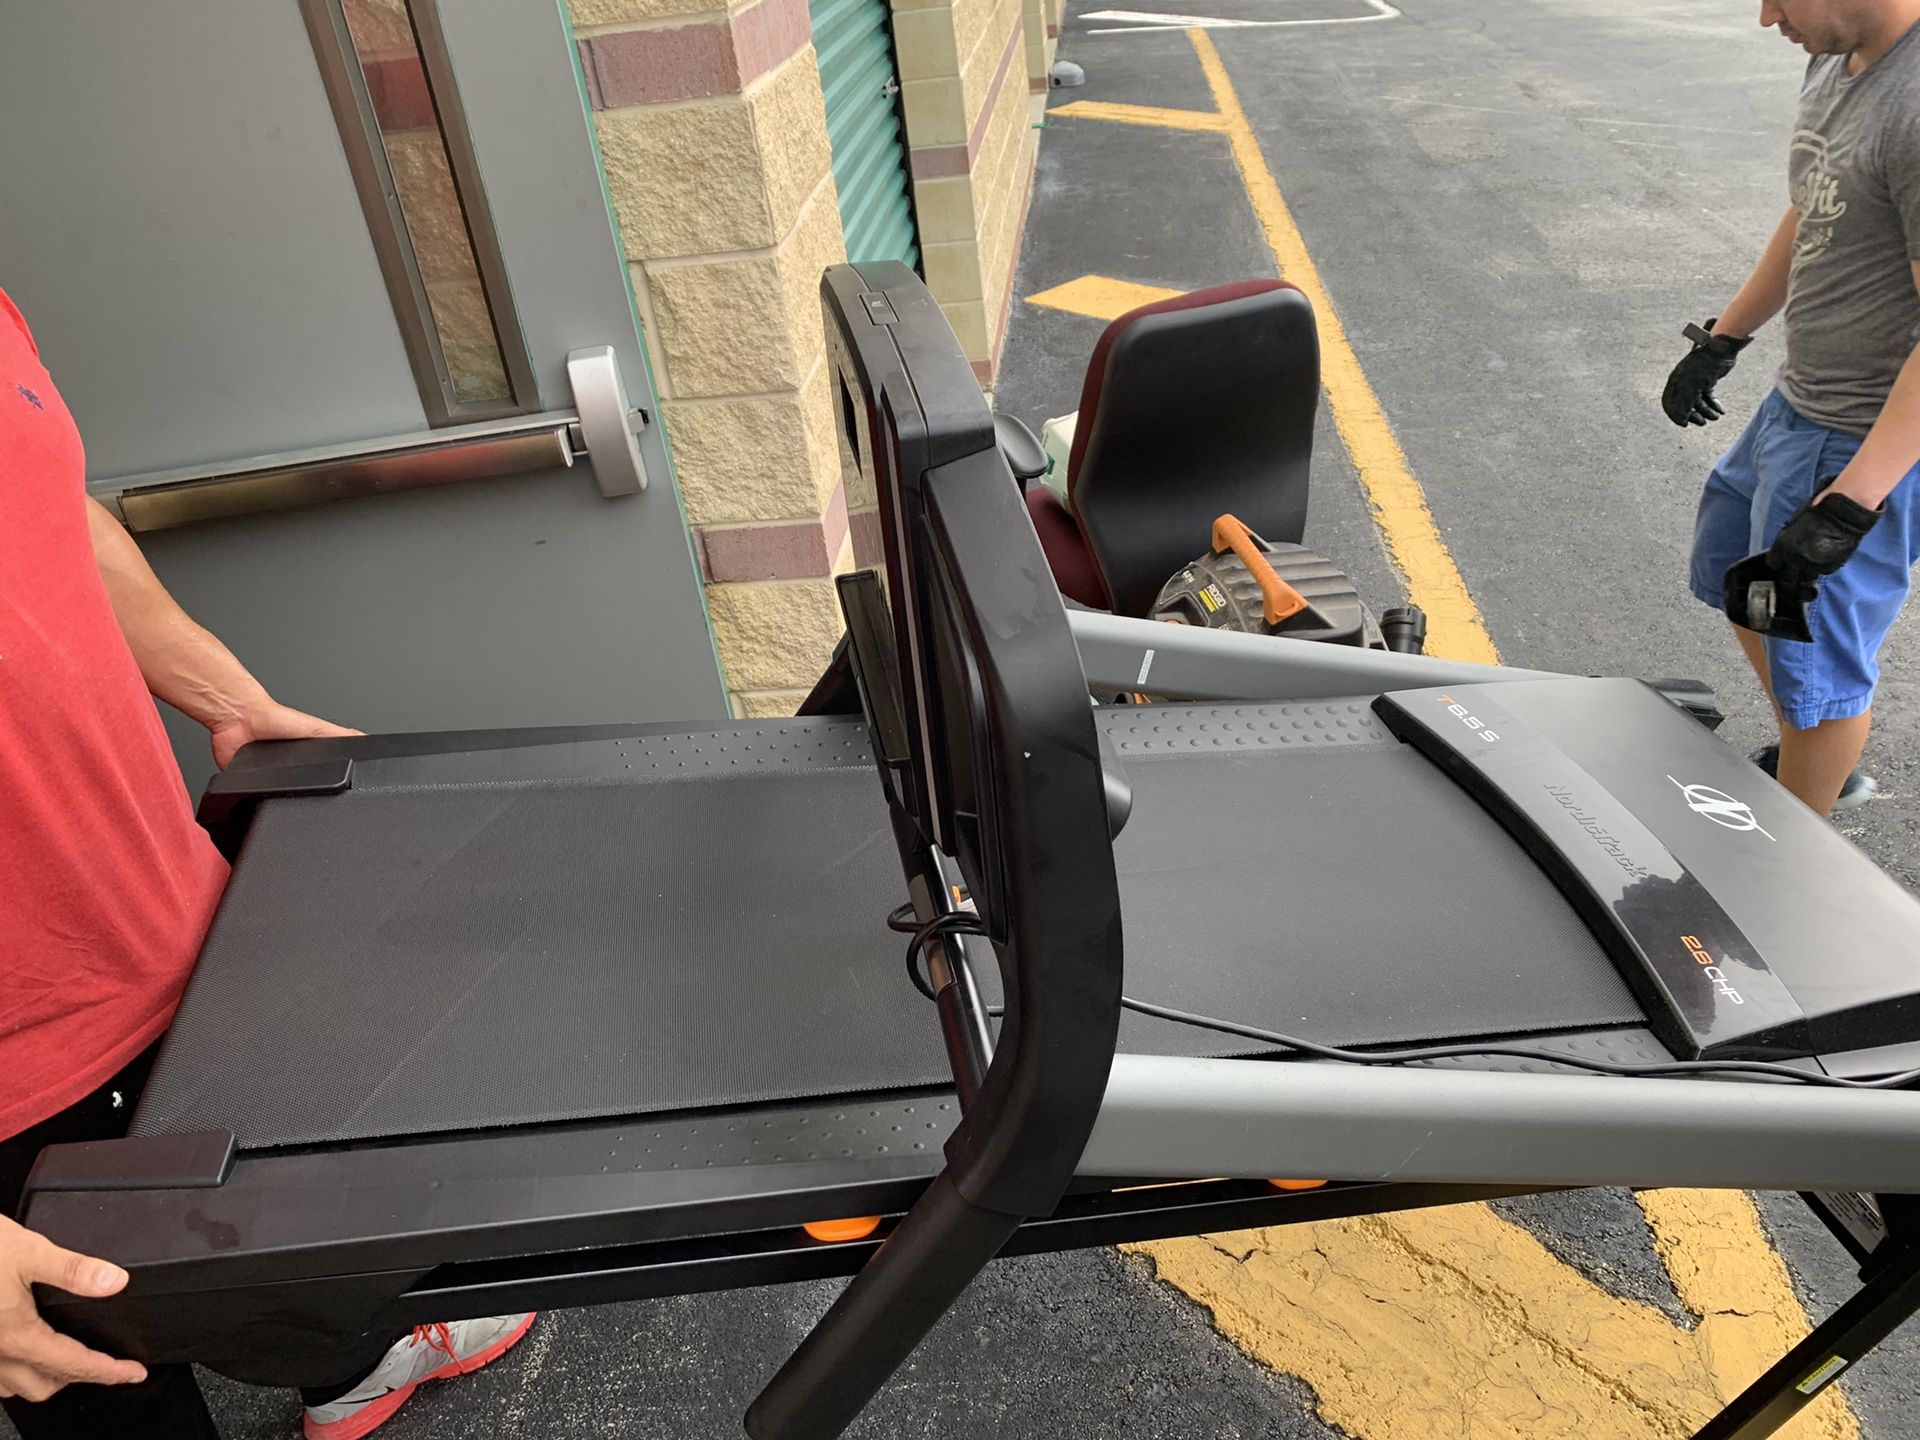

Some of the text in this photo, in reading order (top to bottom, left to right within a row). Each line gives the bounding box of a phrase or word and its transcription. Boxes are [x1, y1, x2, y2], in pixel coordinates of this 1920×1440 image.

[1543, 784, 1648, 878] NordicTrack
[1680, 935, 1744, 1005] 2.6 CHP
